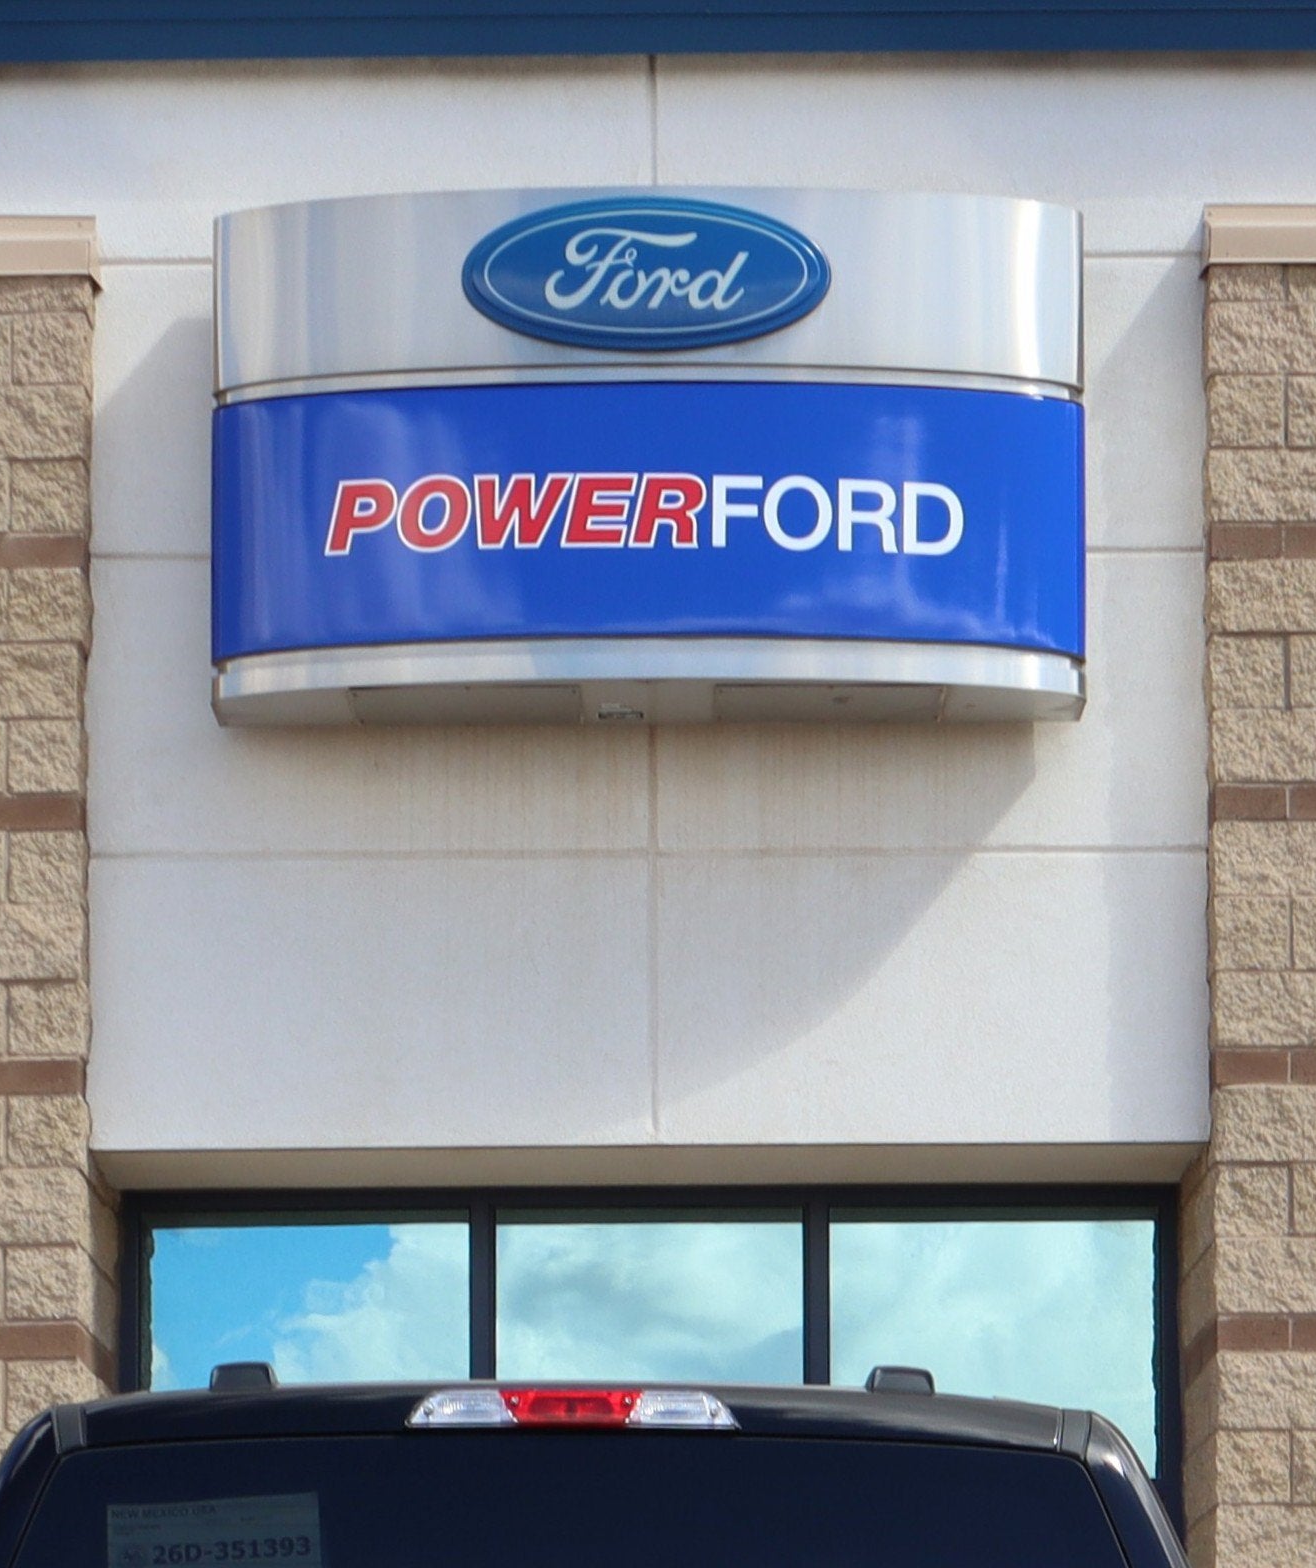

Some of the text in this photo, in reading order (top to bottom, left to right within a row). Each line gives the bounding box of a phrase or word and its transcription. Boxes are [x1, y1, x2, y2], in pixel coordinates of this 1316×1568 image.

[545, 227, 745, 311] Ford
[324, 473, 965, 556] POWERFORD
[111, 1509, 138, 1519] NEW
[142, 1507, 188, 1518] MEXICO
[152, 1535, 311, 1565] 26D-351393
